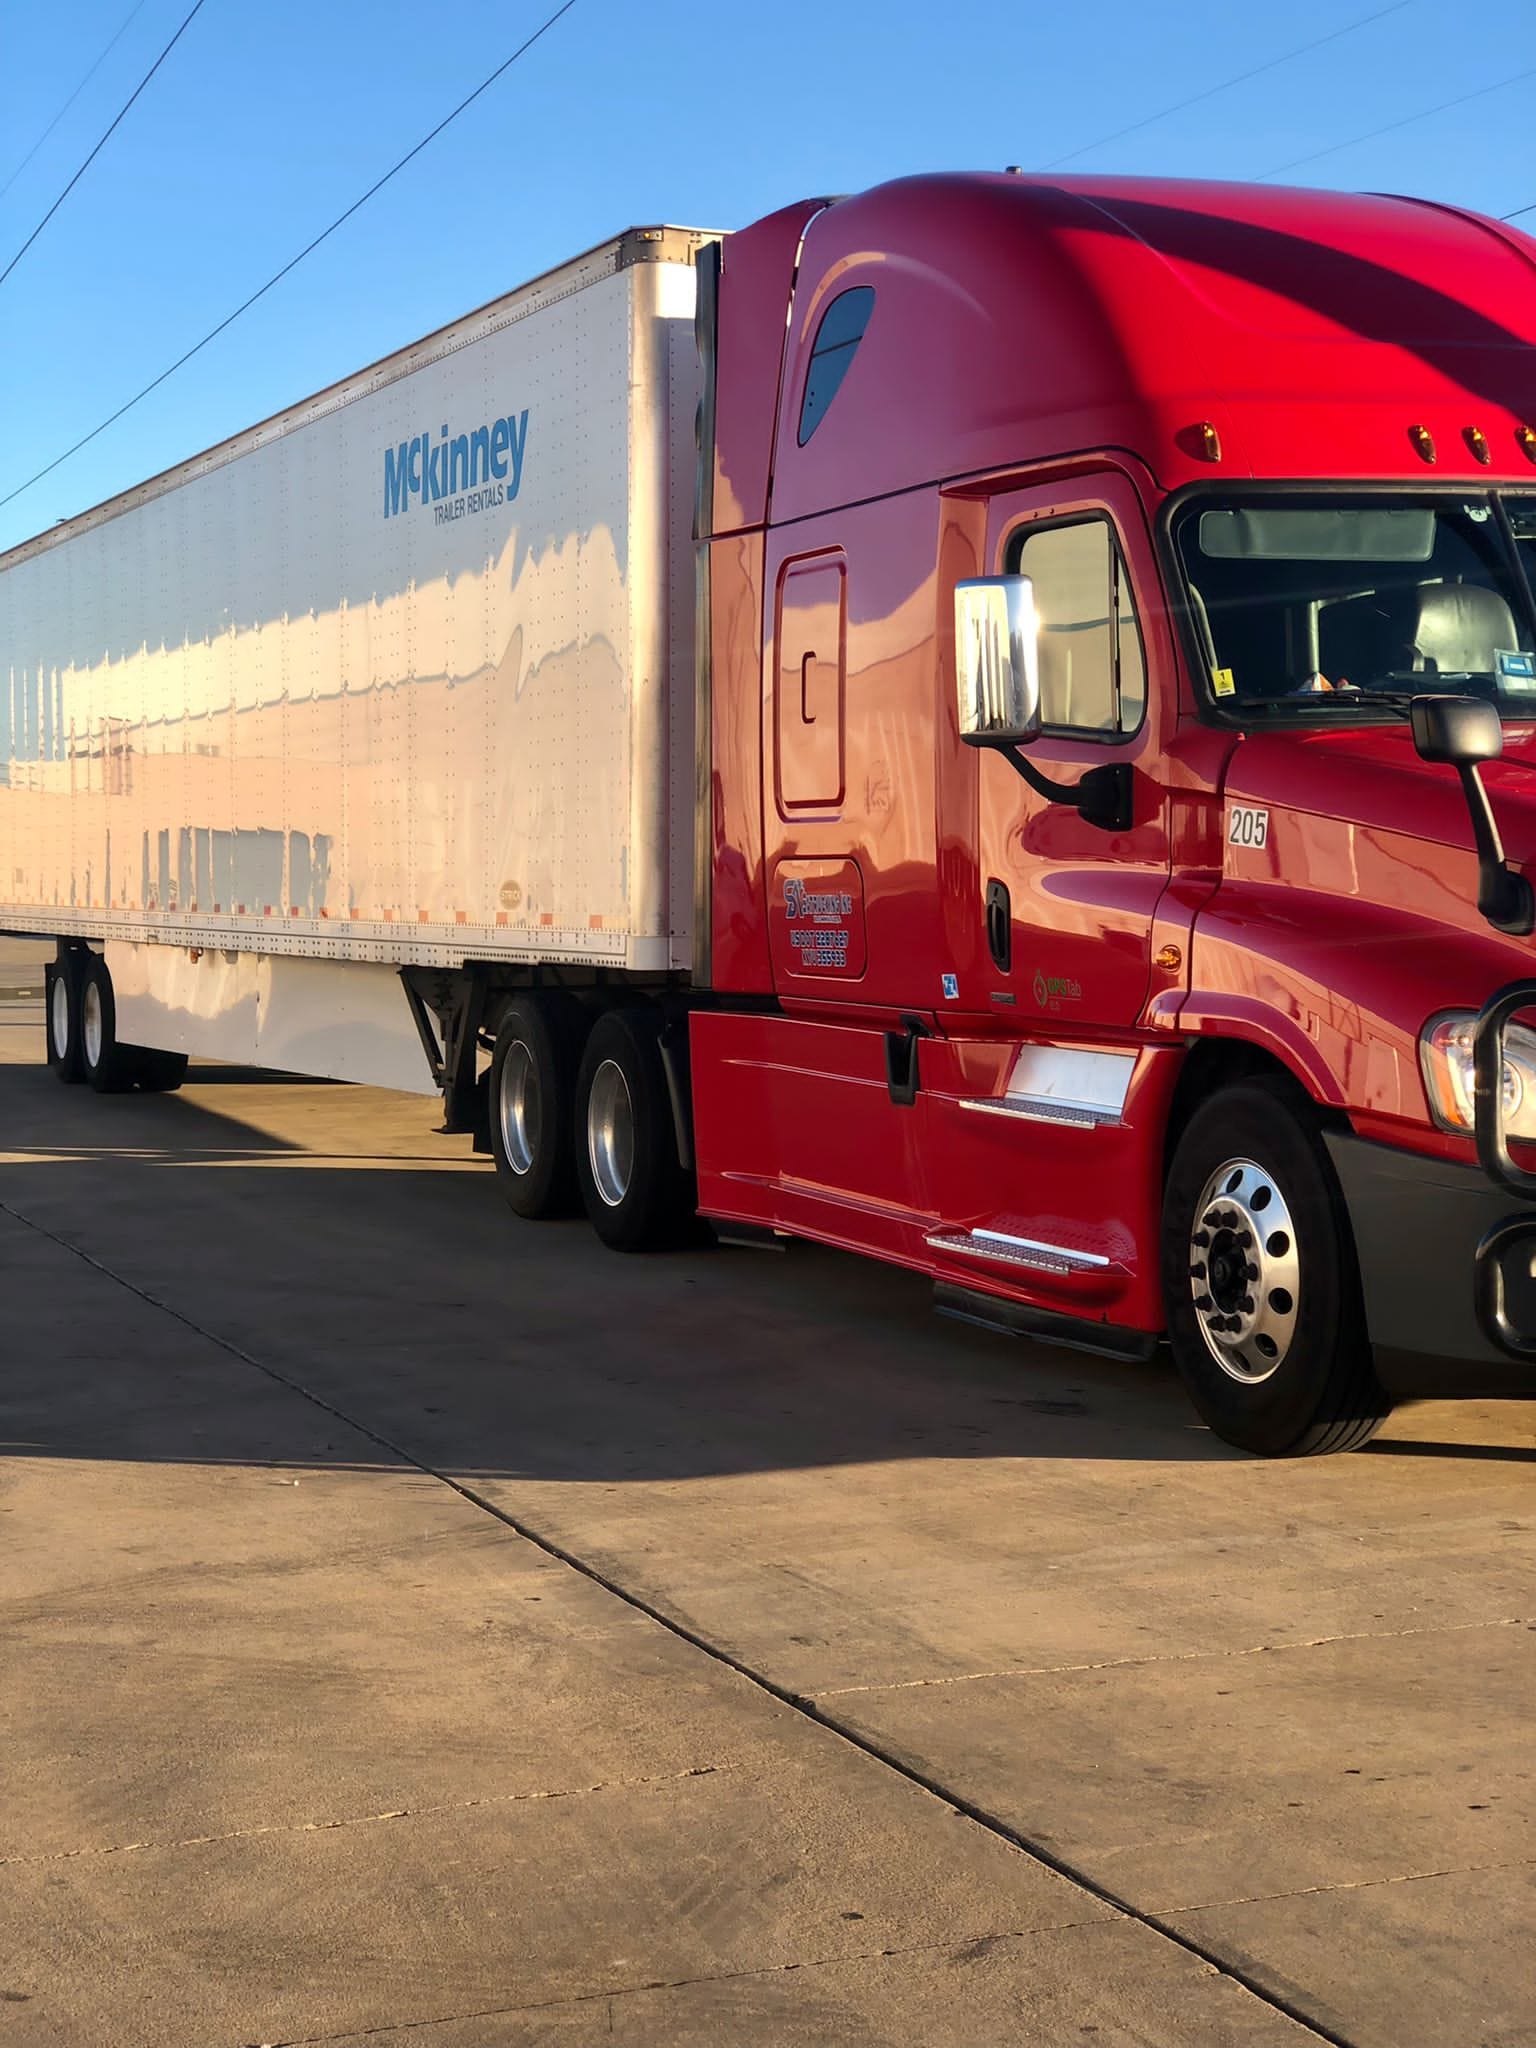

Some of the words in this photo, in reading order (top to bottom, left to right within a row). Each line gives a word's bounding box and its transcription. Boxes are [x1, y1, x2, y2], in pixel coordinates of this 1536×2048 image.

[434, 498, 465, 526] TRAILER
[467, 484, 504, 516] RENTALS
[1230, 809, 1266, 846] 205
